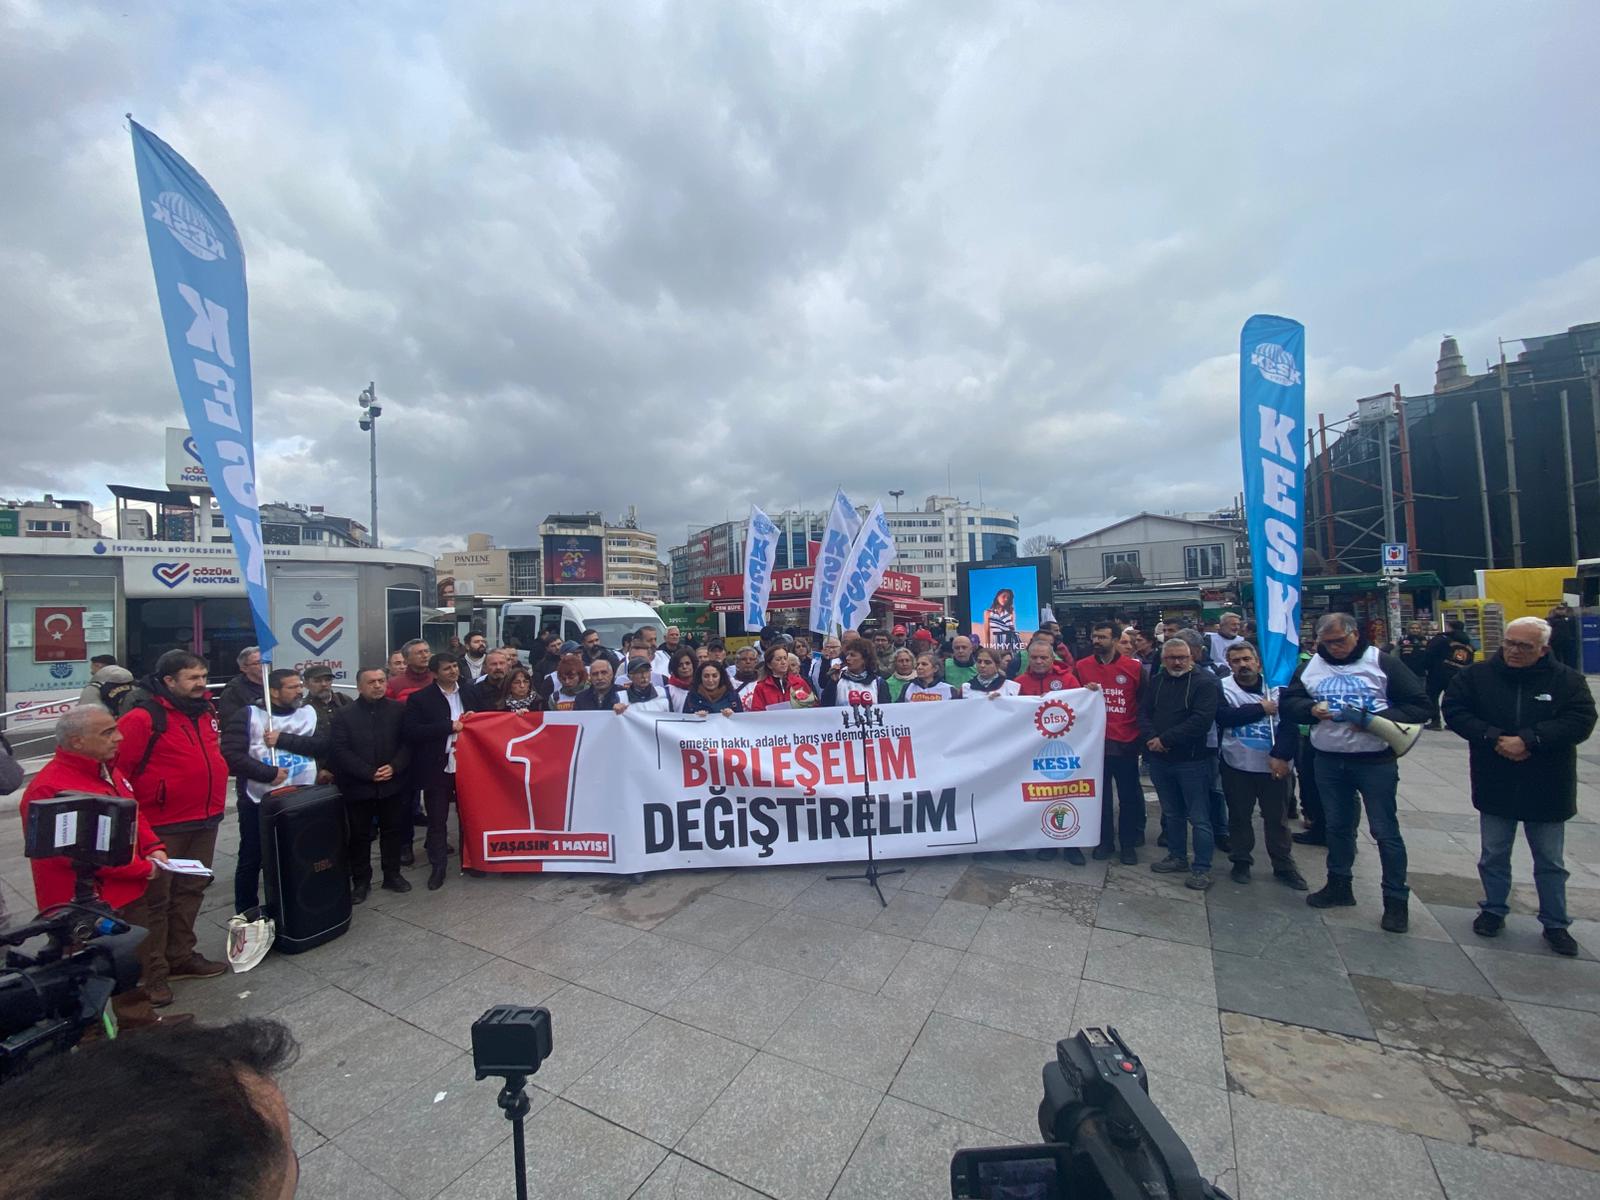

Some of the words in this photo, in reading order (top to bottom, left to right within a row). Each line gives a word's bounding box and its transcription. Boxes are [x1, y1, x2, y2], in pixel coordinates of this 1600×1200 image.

[1249, 352, 1301, 384] KESK
[184, 465, 206, 475] ÇÖZ
[180, 474, 208, 482] NOKT
[1258, 405, 1299, 646] KESK
[168, 546, 232, 555] BÜYÜKŞEHİR
[193, 567, 232, 577] ÇÖZÜM
[839, 529, 888, 630] KESK
[782, 573, 814, 591] BÜF
[895, 576, 912, 593] BÜFE
[38, 704, 71, 715] ALO
[1043, 713, 1068, 725] DİSK
[679, 738, 718, 752] emeğin
[721, 737, 754, 750] hakkı,
[756, 734, 791, 748] adalet,
[794, 732, 820, 746] barış
[822, 733, 833, 743] ve
[835, 726, 889, 742] demokrasi
[891, 726, 911, 740] için
[1232, 726, 1272, 738] KES
[681, 735, 917, 796] BİRLEŞELİM
[1032, 756, 1081, 771] KESK
[1027, 781, 1090, 797] tmmob
[643, 785, 957, 858] DEĞİŞTİRELİM
[490, 841, 549, 854] YAŞASIN
[552, 840, 559, 851] 1
[562, 840, 608, 852] MAYIS!
